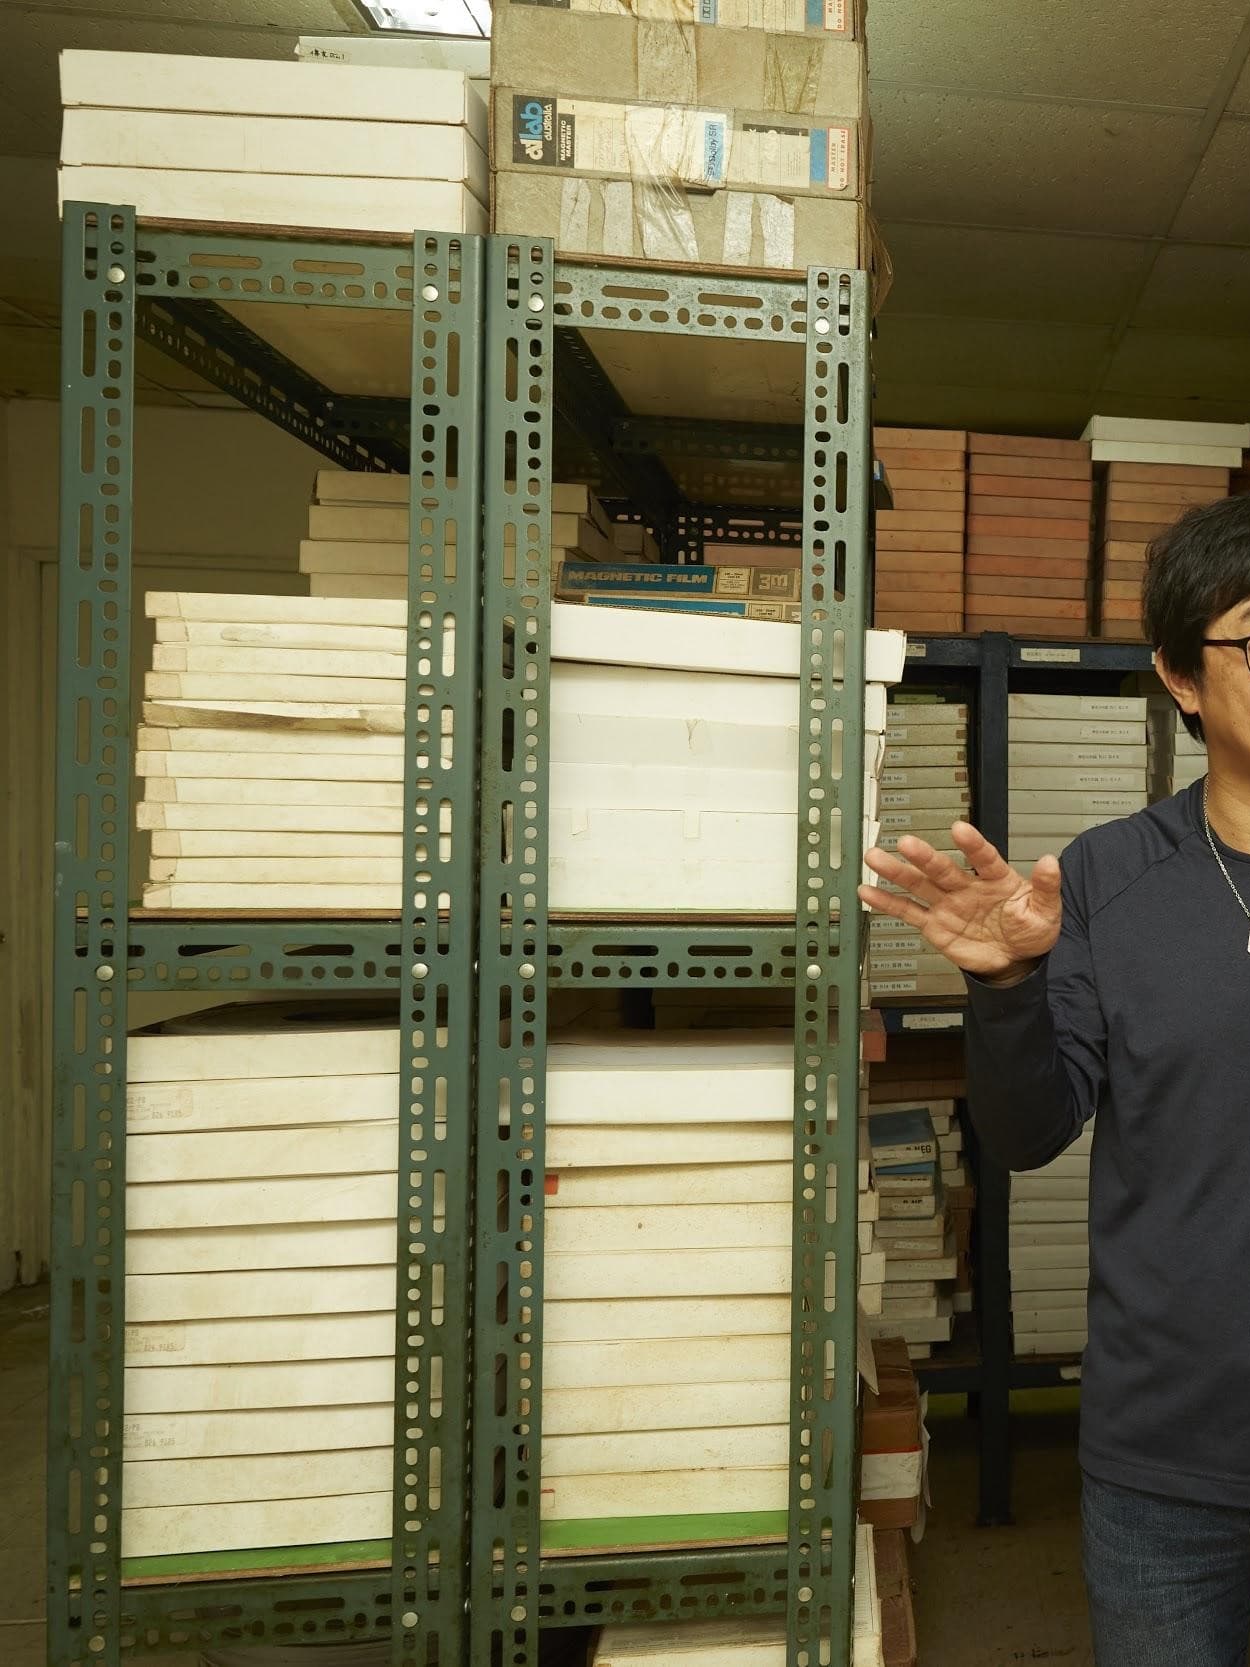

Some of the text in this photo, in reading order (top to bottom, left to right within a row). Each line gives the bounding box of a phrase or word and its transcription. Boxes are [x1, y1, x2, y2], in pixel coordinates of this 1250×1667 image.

[568, 570, 662, 583] MAGNETIC
[667, 573, 708, 584] FILM
[759, 573, 788, 590] 3M
